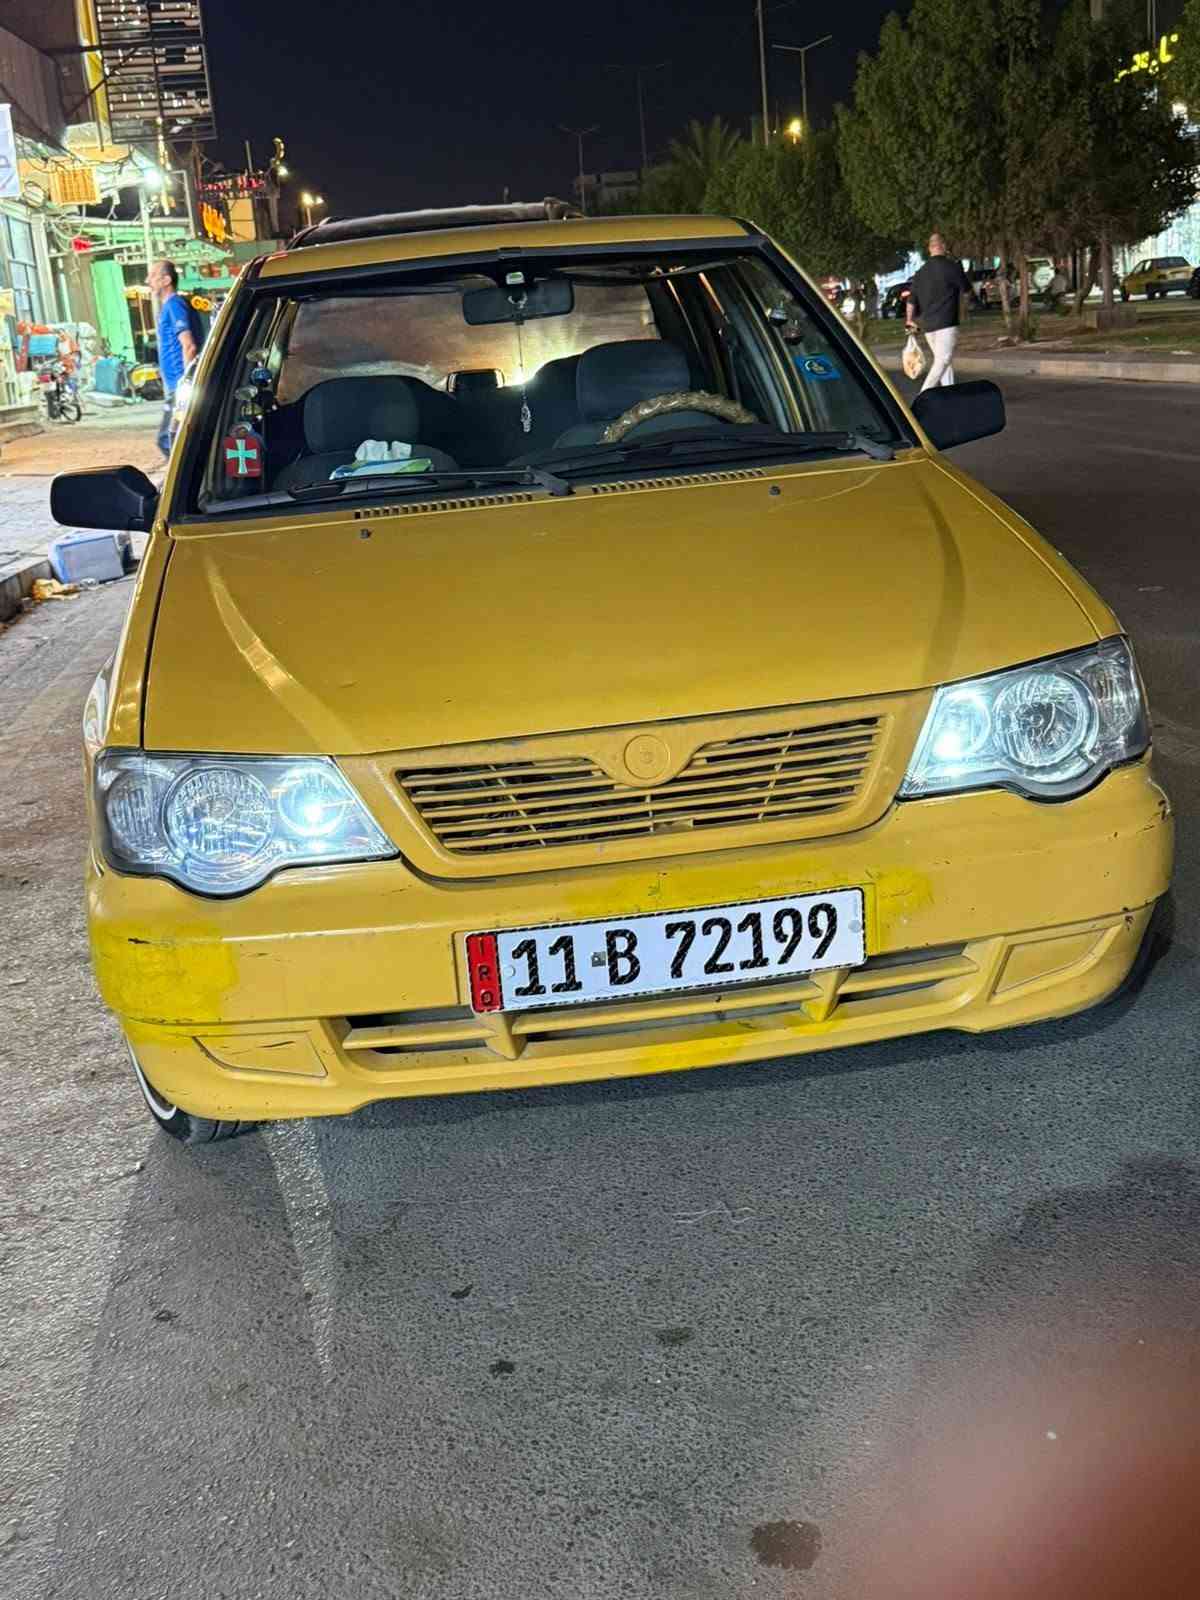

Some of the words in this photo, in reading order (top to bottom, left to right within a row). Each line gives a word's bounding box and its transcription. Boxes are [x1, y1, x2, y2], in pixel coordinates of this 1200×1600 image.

[511, 934, 583, 996] 11
[606, 929, 641, 986] B
[665, 902, 838, 979] 72199
